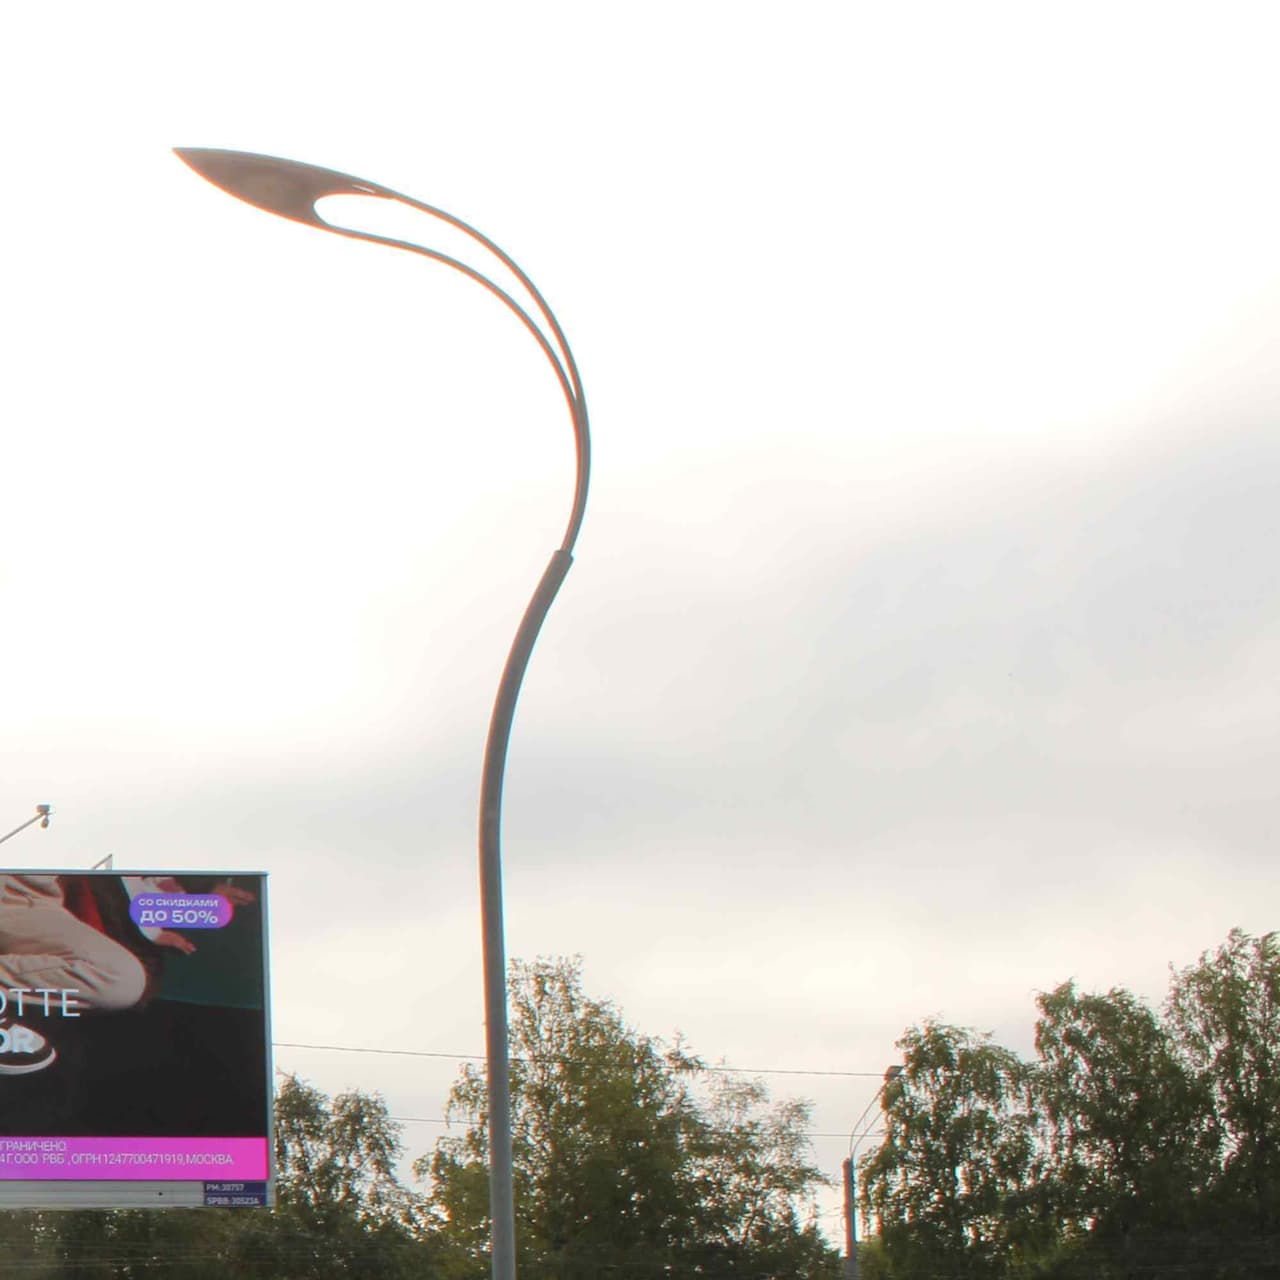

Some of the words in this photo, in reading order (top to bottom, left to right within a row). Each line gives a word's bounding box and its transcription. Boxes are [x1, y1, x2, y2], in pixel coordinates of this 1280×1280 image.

[156, 899, 218, 907] СКИДКАМИ
[141, 910, 168, 923] ДО
[172, 910, 218, 924] 50%
